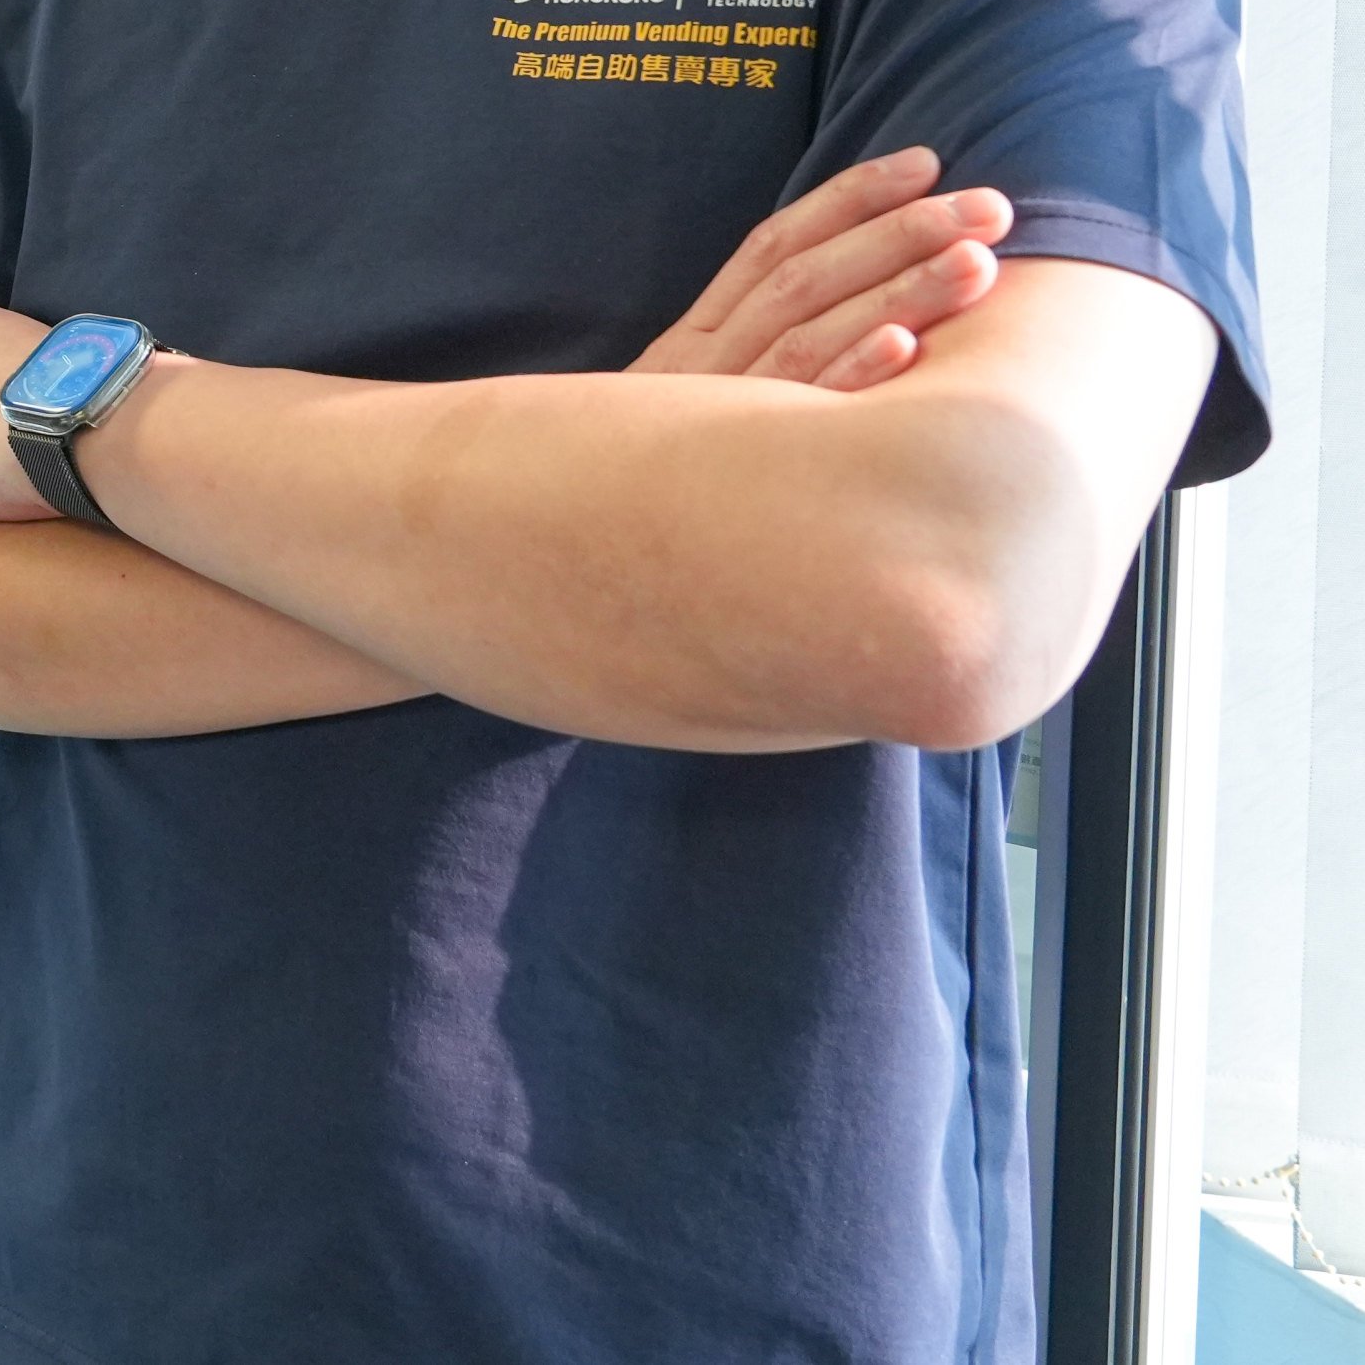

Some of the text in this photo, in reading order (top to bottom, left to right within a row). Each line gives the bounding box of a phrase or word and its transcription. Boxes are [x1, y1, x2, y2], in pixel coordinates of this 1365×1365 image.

[491, 17, 531, 41] The
[534, 21, 630, 42] Premium
[635, 21, 729, 46] Vending
[511, 51, 778, 89] 高端自助售賣專家
